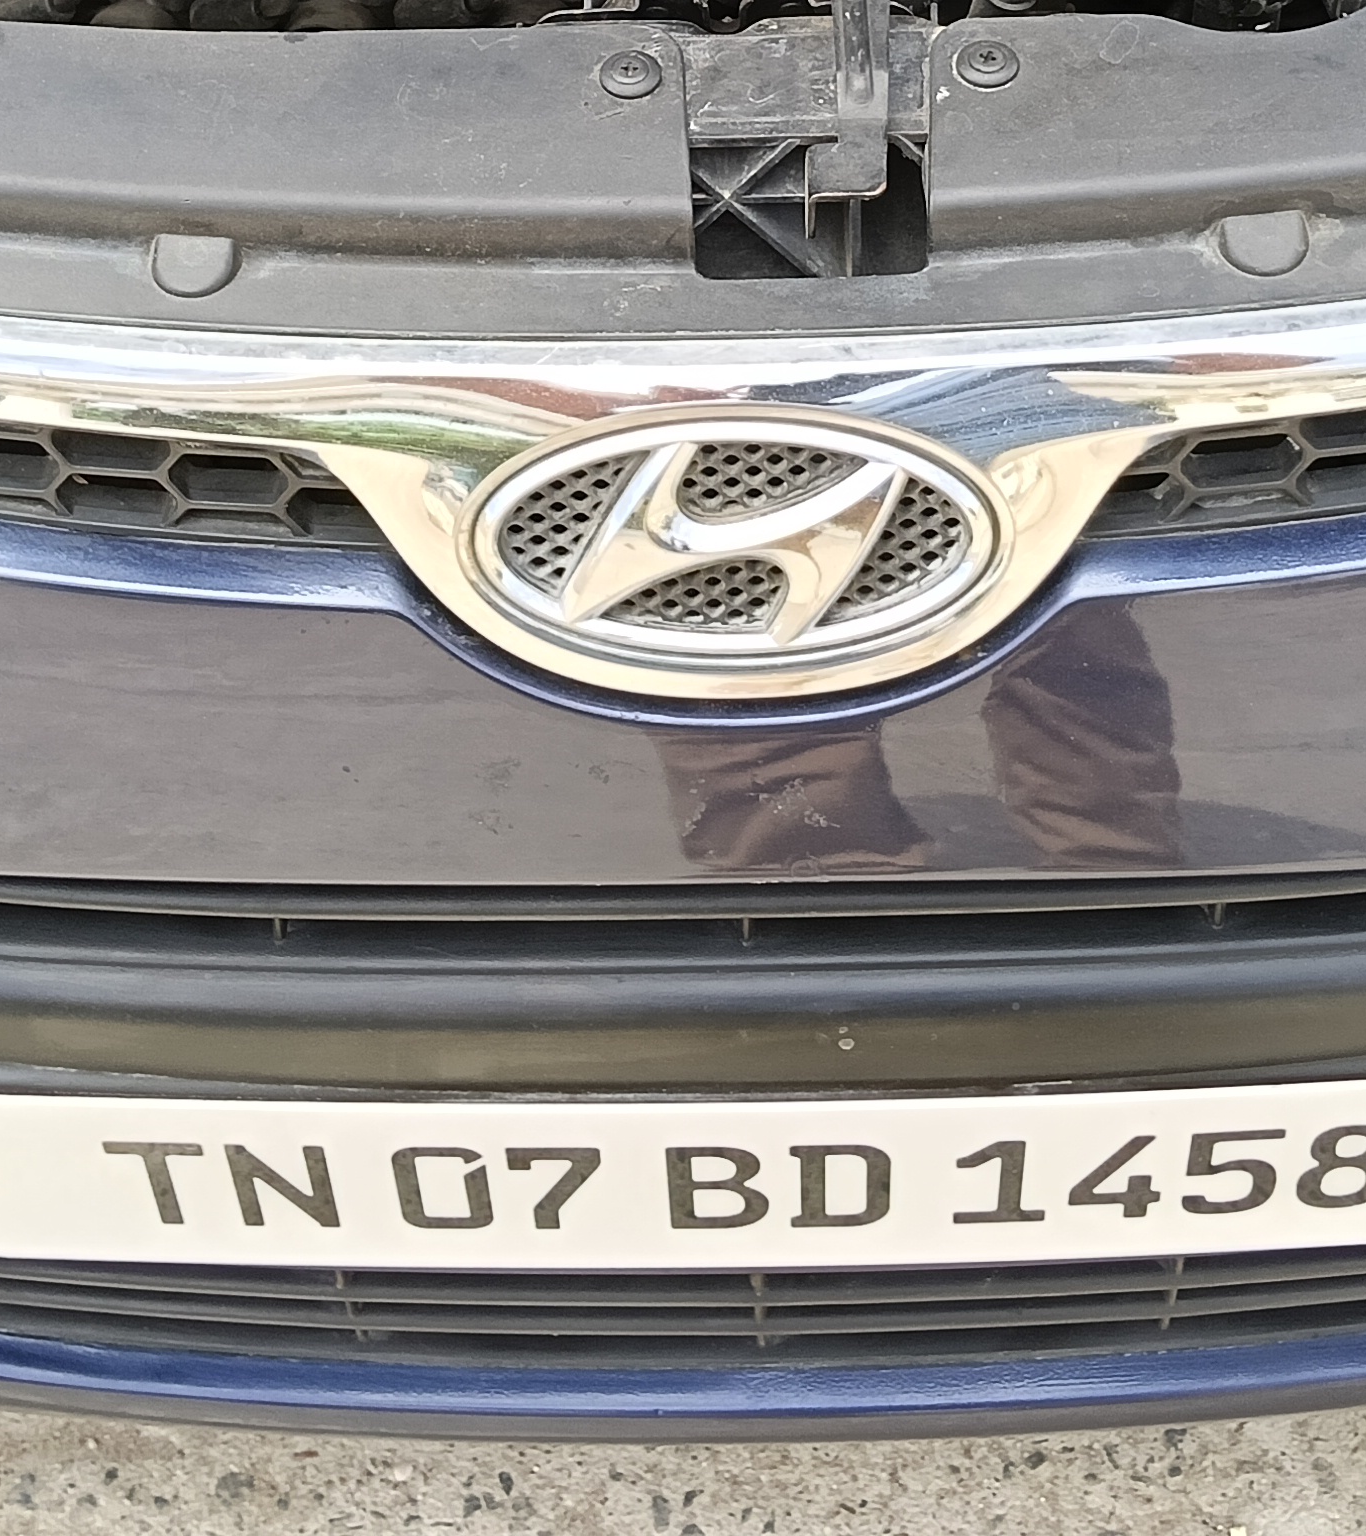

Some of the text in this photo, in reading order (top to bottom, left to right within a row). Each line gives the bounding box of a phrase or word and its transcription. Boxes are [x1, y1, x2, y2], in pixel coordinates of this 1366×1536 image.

[104, 1140, 340, 1227] TN
[392, 1147, 601, 1229] 07
[666, 1145, 892, 1228] BD
